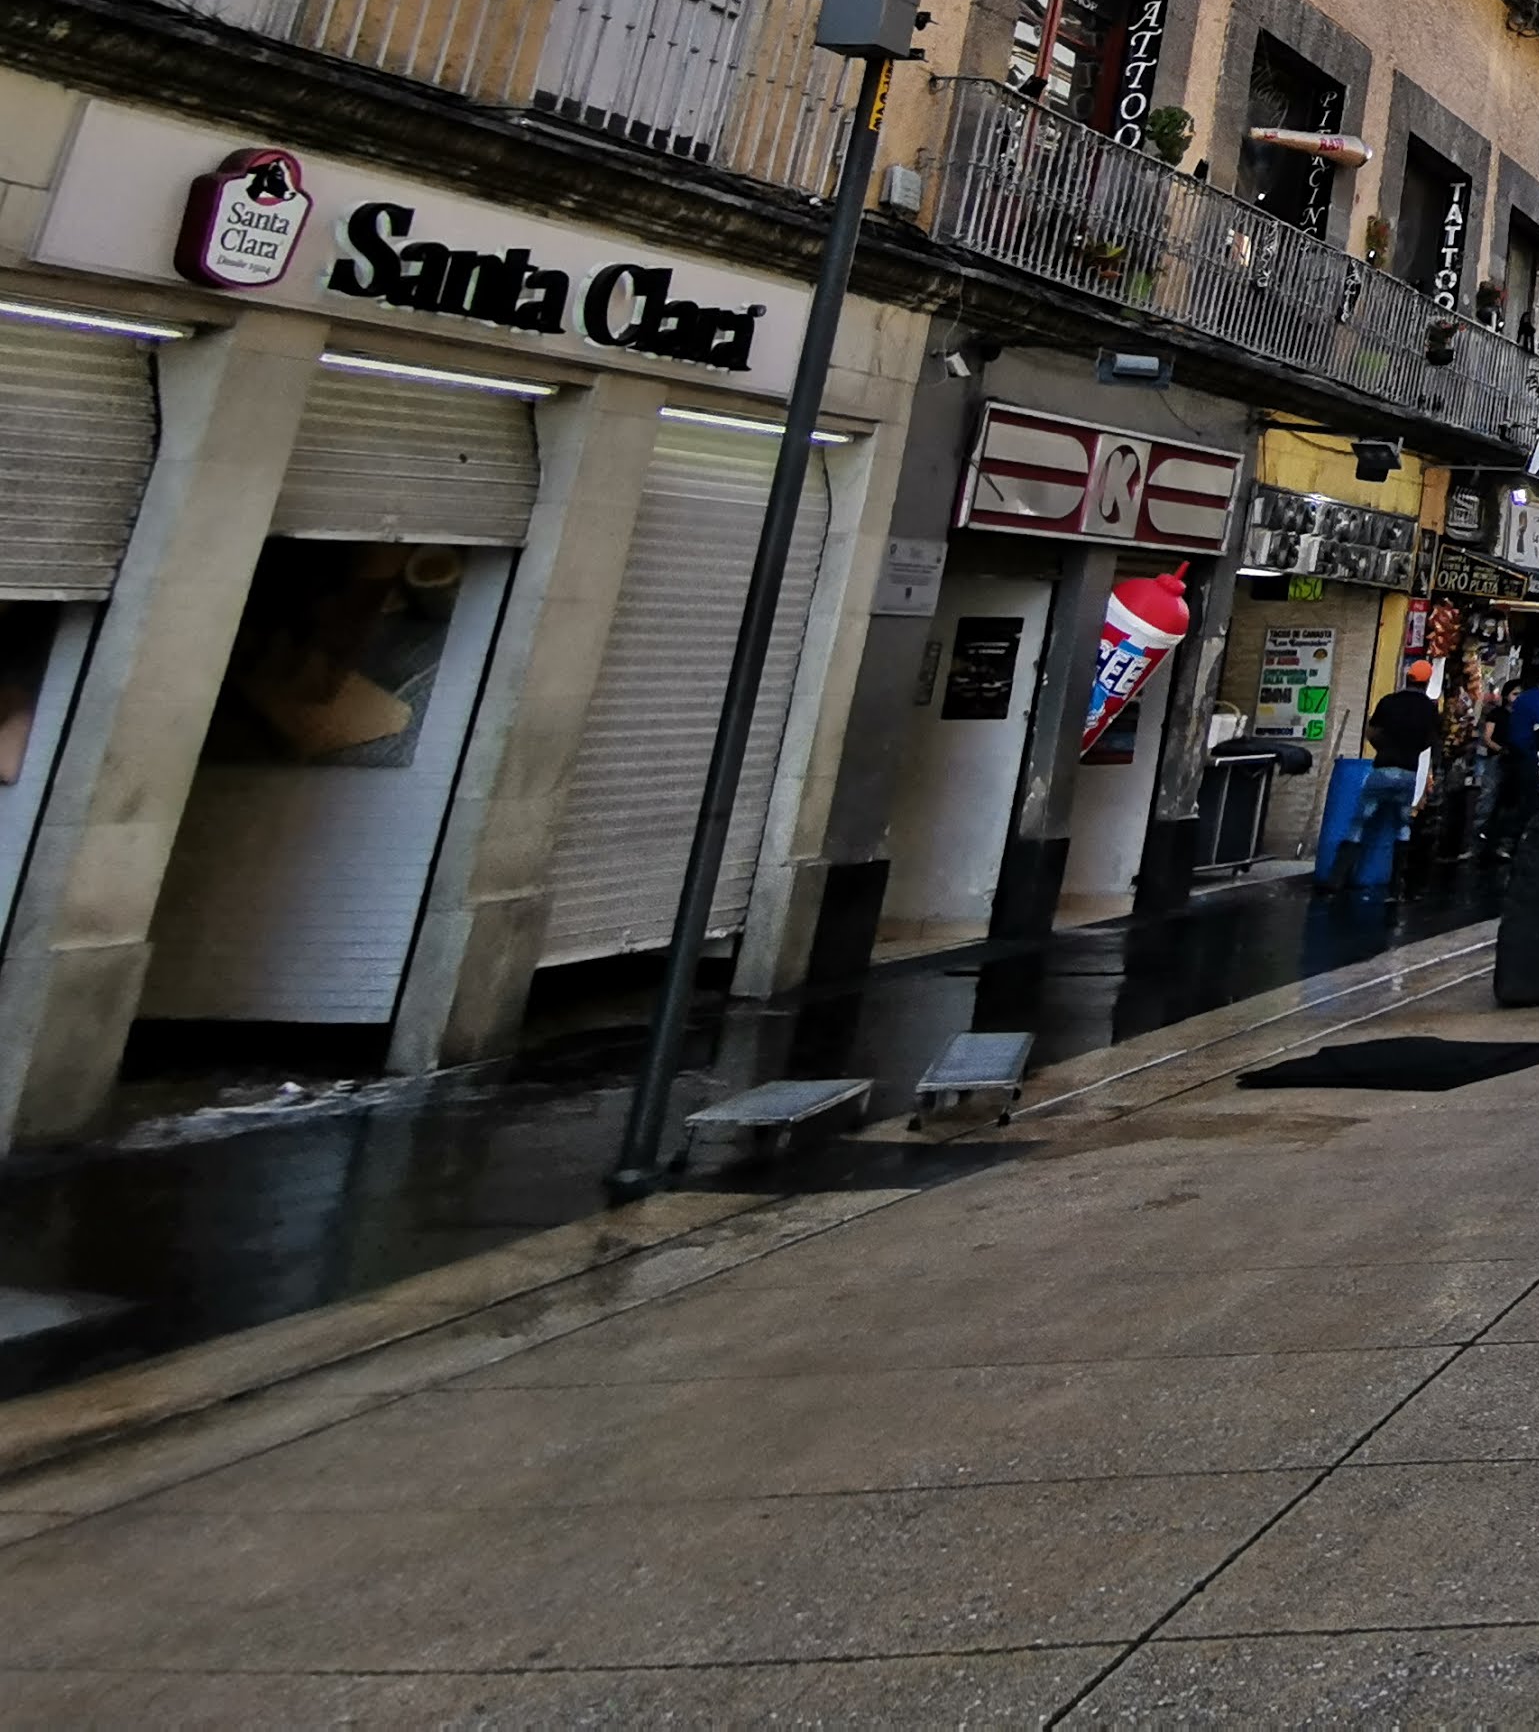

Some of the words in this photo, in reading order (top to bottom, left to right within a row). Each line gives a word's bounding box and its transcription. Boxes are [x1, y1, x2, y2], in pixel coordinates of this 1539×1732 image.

[226, 201, 290, 236] Santa
[220, 227, 279, 260] Clara
[1433, 182, 1467, 311] TATTOO
[325, 200, 571, 335] Santa
[580, 262, 756, 373] Clara
[1437, 569, 1469, 591] ORO
[1469, 579, 1499, 597] PLATA
